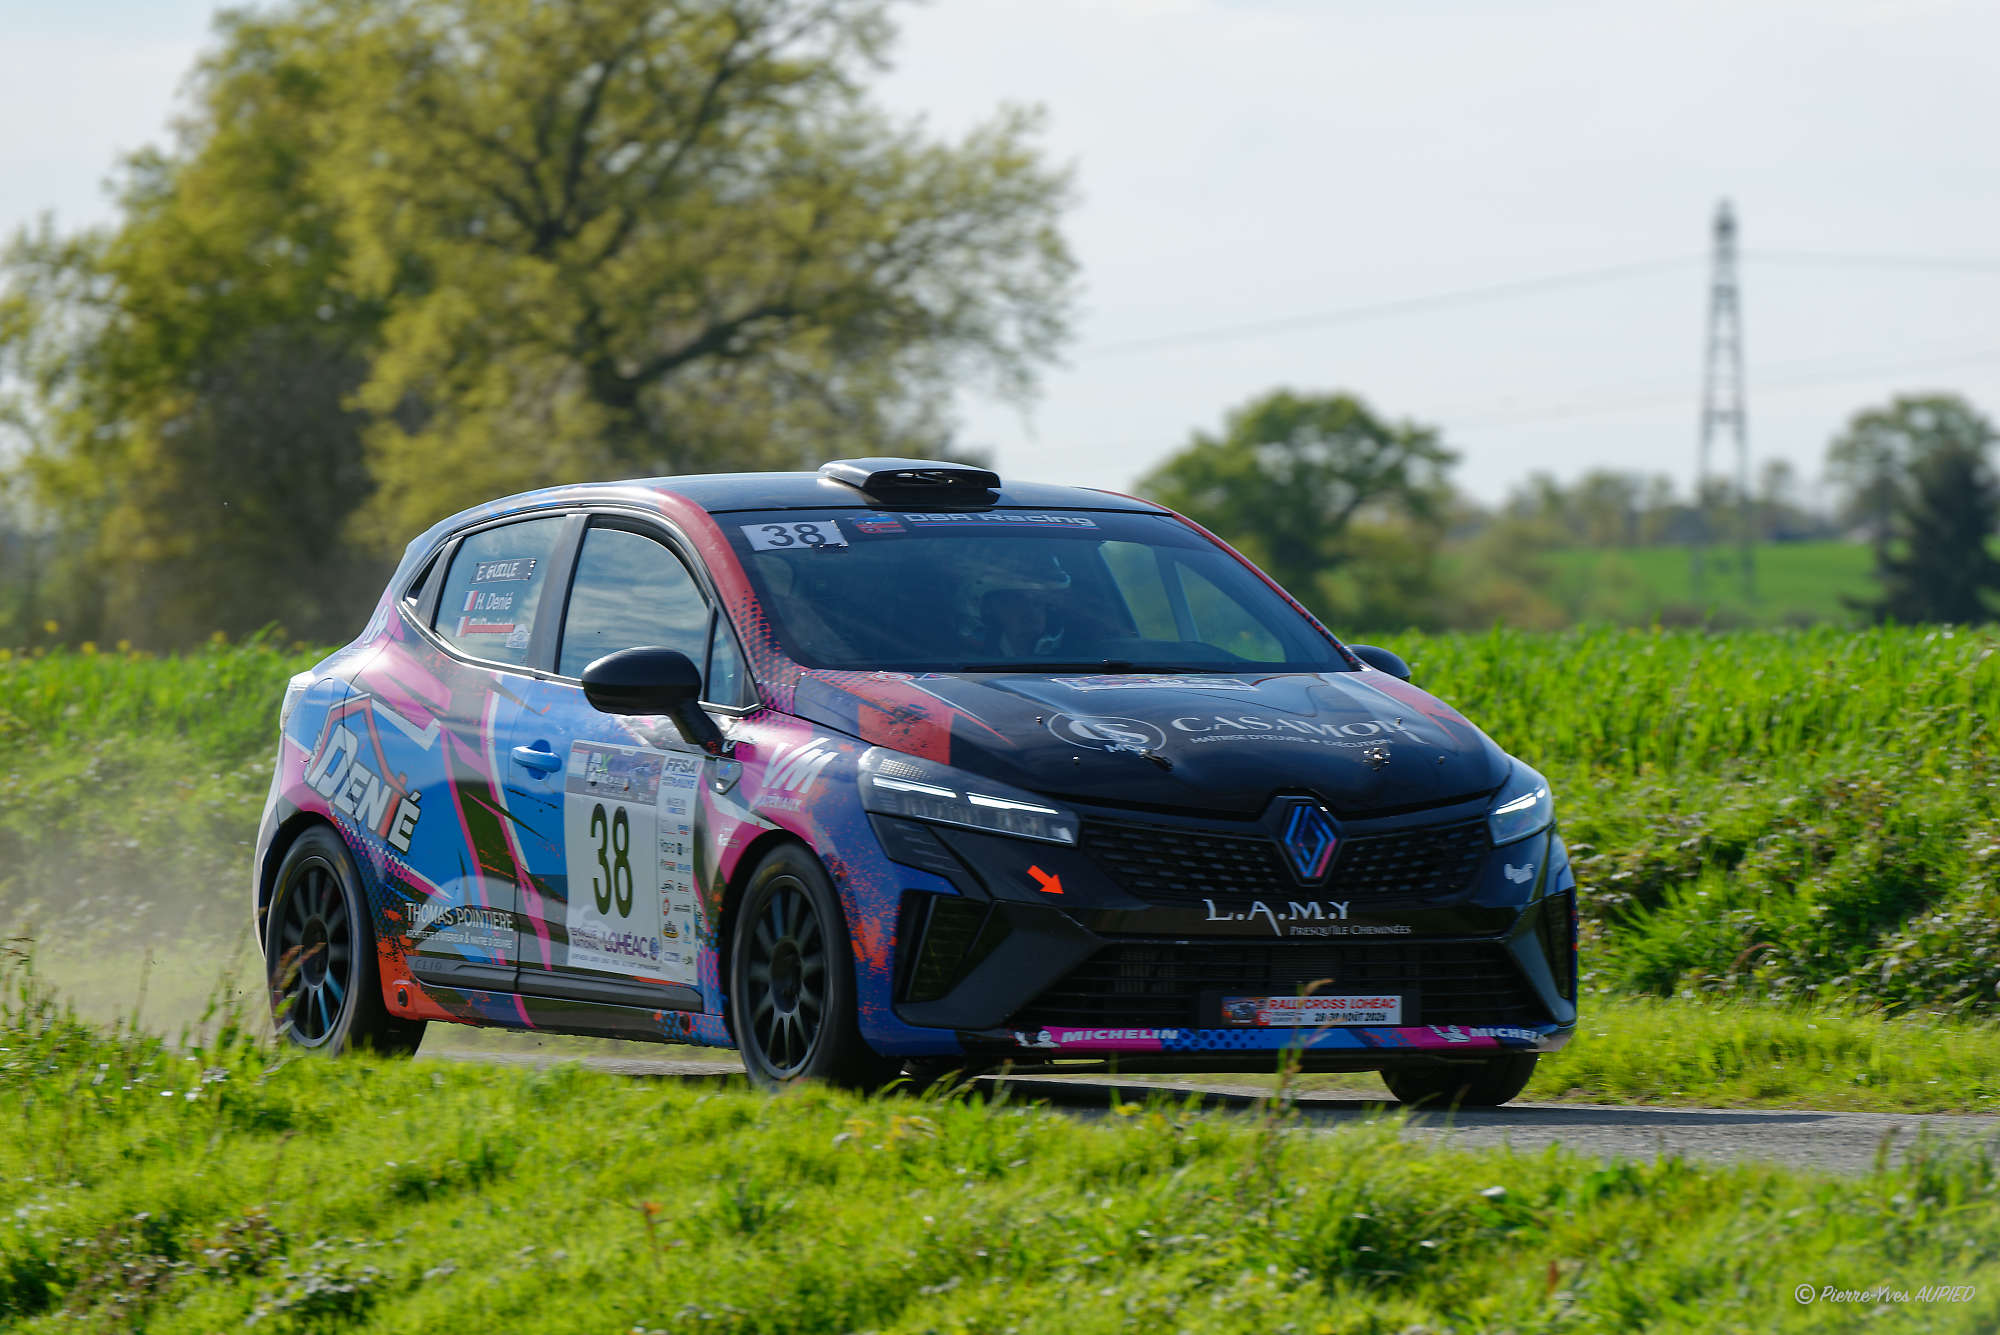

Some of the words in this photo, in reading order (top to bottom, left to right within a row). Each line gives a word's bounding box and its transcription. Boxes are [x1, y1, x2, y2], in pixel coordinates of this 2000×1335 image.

[976, 514, 1097, 527] Racing
[760, 524, 826, 547] 38
[486, 591, 515, 611] Denié
[664, 757, 698, 773] FFSA
[304, 724, 422, 856] DENIÉ
[590, 803, 633, 918] 38
[405, 902, 454, 926] THOMAS
[456, 907, 514, 932] POINTIERE
[602, 930, 648, 959] LOHÉAC
[1350, 998, 1396, 1010] LOHÉAC
[1060, 1029, 1179, 1043] MICHELIN
